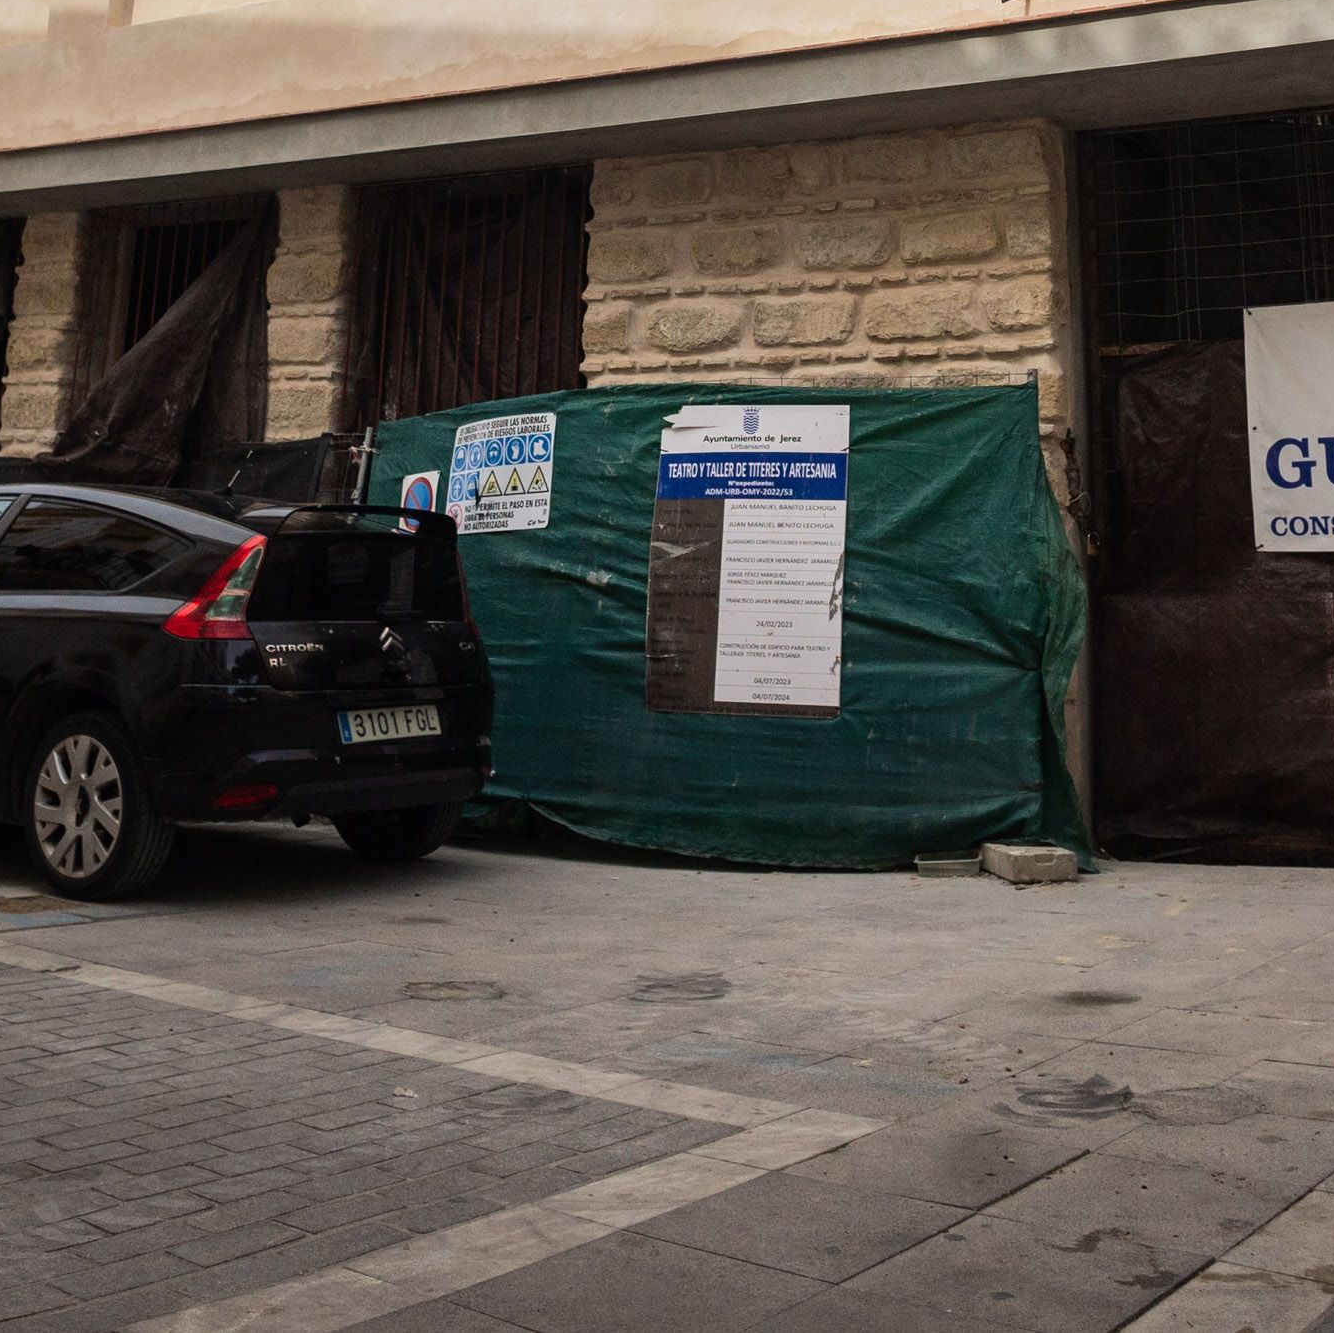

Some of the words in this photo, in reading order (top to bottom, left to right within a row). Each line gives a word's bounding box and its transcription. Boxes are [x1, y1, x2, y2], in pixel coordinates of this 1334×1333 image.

[510, 417, 520, 426] LAS
[520, 415, 548, 425] NORMAS
[494, 426, 516, 437] RIESGOS
[517, 424, 550, 434] LABORALES
[703, 435, 762, 444] Ayuntamiento
[779, 435, 802, 443] Jerez
[668, 463, 699, 479] TEATRO
[699, 463, 706, 478] Y
[706, 463, 735, 478] TALLER
[736, 463, 747, 478] DE
[748, 462, 780, 478] TITERES
[782, 463, 789, 478] Y
[478, 502, 501, 511] ERMITE
[502, 501, 508, 510] EL
[510, 500, 524, 509] PASO
[525, 499, 534, 508] EN
[535, 498, 548, 507] ESTA
[472, 520, 508, 530] AUTORIZADAS
[265, 643, 324, 652] CITROËN
[753, 677, 791, 685] 04/07/2023
[752, 693, 790, 701] 04/07/2024
[355, 711, 400, 737] 3101
[405, 709, 437, 733] FGL
